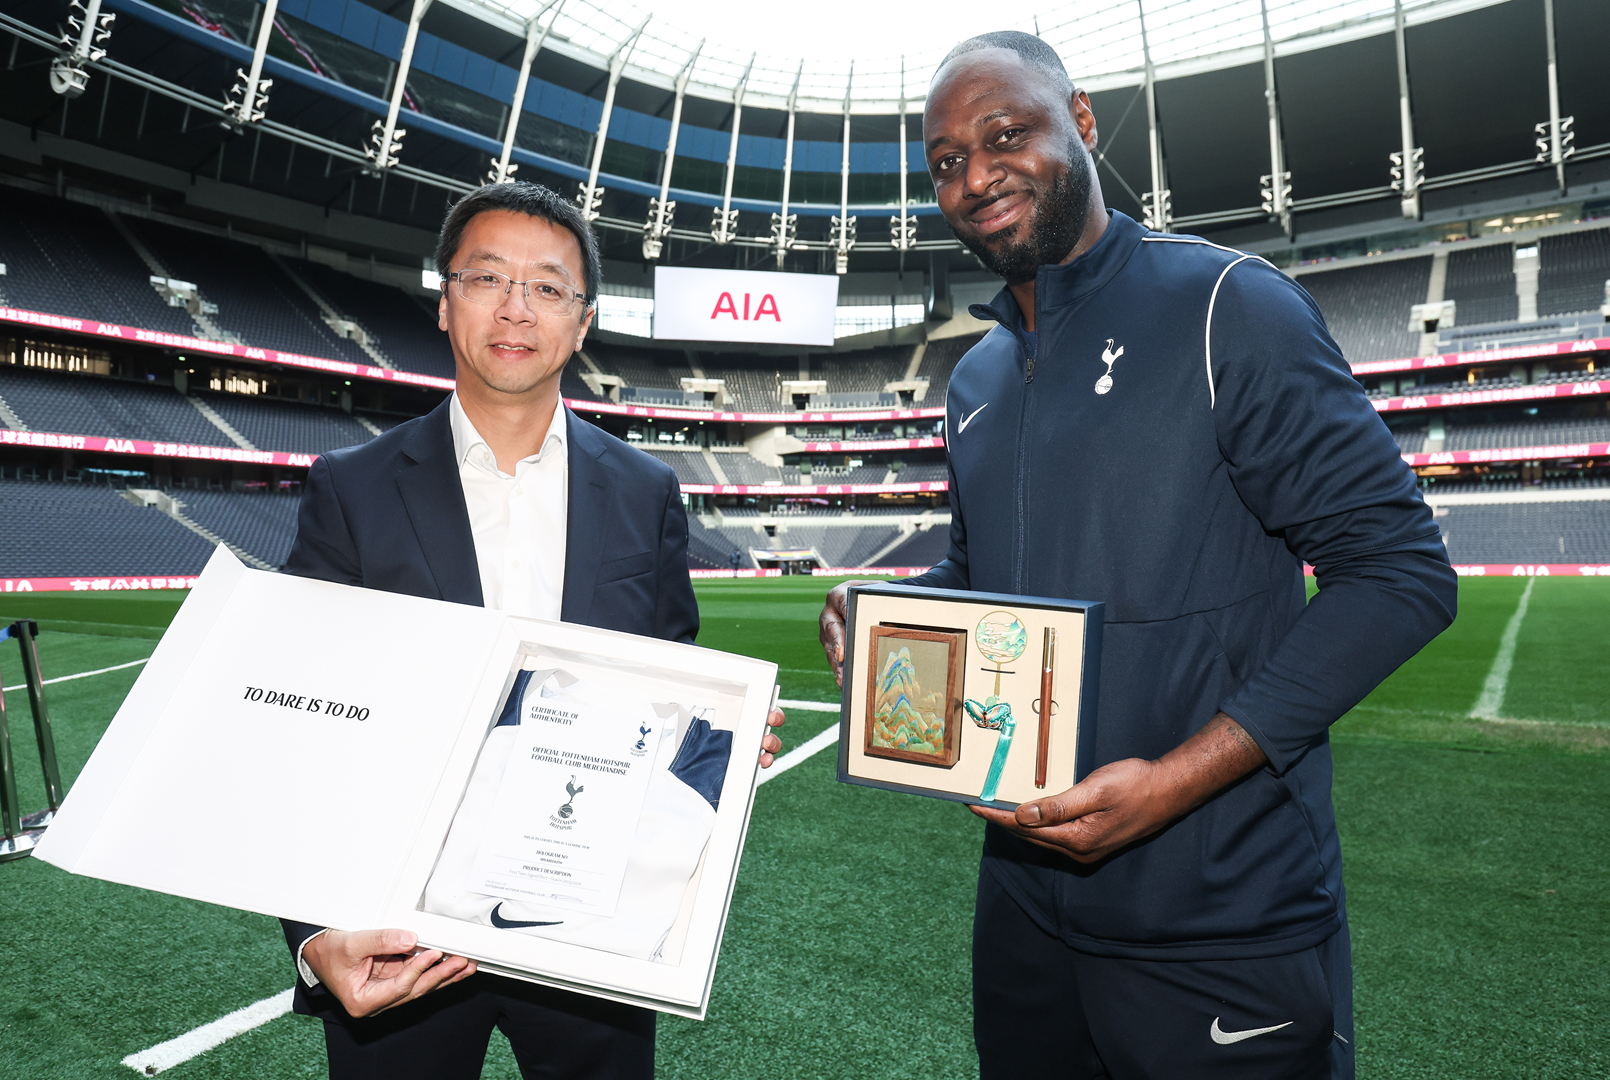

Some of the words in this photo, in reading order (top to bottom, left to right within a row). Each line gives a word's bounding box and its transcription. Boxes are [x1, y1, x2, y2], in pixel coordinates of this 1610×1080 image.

[710, 291, 782, 322] AIA
[96, 324, 122, 337] AIA
[1571, 340, 1597, 352] AIA
[245, 347, 266, 360] AIA
[1422, 356, 1446, 367] AIA
[366, 366, 384, 378] AIA
[1572, 382, 1601, 394] AIA
[1402, 396, 1428, 409] AIA
[634, 407, 648, 416] AIA
[720, 412, 735, 420] AIA
[810, 413, 825, 422] AIA
[899, 410, 913, 418] AIA
[104, 438, 136, 453] AIA
[816, 442, 832, 451] AIA
[918, 438, 934, 448] AIA
[288, 454, 312, 466] AIA
[1428, 452, 1455, 464] AIA
[722, 485, 738, 494] AIA
[826, 485, 843, 494] AIA
[928, 481, 946, 490] AIA
[1512, 565, 1550, 576] AIA
[0, 580, 33, 592] IA
[244, 686, 264, 702] TO
[264, 690, 306, 710] DARE
[306, 698, 322, 712] IS
[325, 701, 344, 716] TO
[346, 706, 370, 721] DO
[532, 706, 569, 718] CERTIFICATE
[529, 712, 574, 726] AUTHENTICITY
[532, 746, 560, 756] OFFICIAL
[561, 750, 600, 764] TOTTENHAM
[600, 758, 630, 768] HOTSPUR
[531, 754, 563, 765] FOOTBALL
[564, 759, 582, 768] CLUB
[582, 763, 628, 776] MERCHANDISE
[550, 814, 578, 825] TOTTENHAM
[536, 850, 561, 858] HOLOGRAM
[522, 865, 543, 873] PRODUCT
[544, 868, 572, 877] DESCRIPTION
